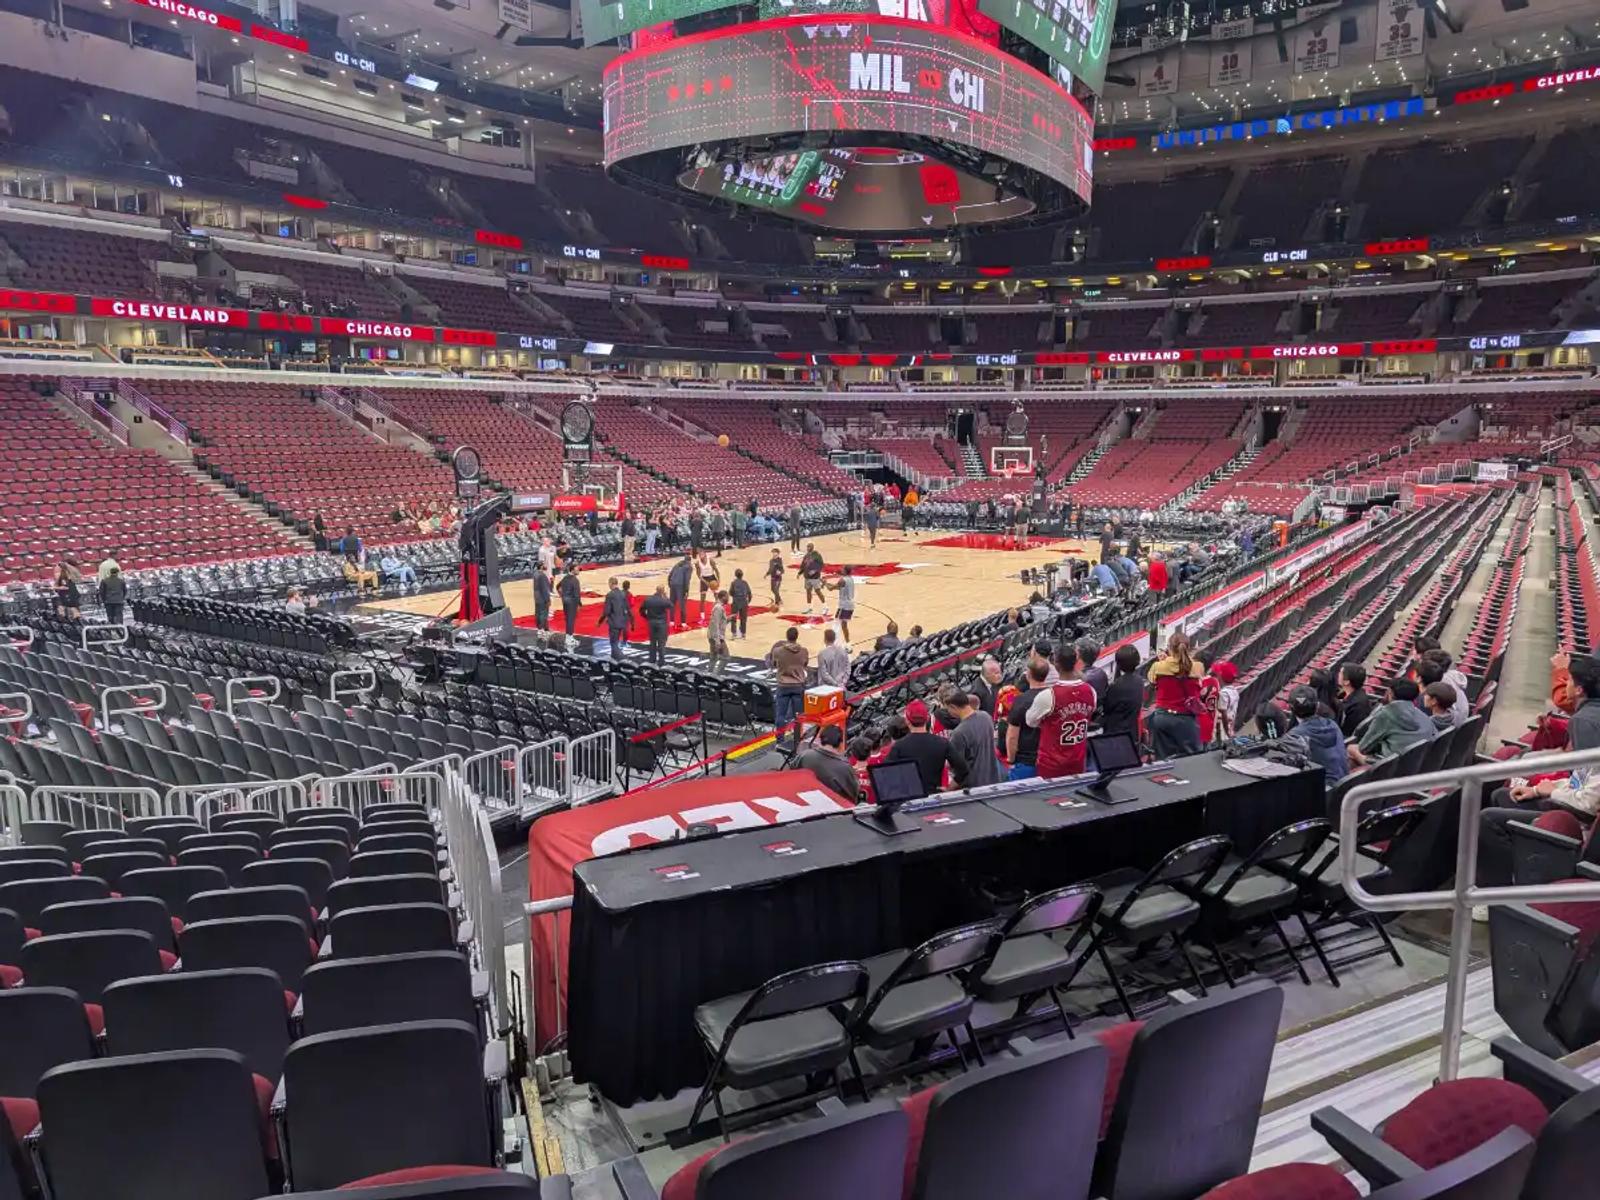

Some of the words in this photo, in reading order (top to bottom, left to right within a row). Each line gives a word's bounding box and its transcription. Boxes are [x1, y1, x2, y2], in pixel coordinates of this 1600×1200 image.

[1307, 38, 1328, 56] 23
[335, 51, 349, 65] CLE
[360, 58, 376, 73] CHI
[1153, 65, 1164, 80] 4
[850, 52, 910, 93] MIL
[948, 67, 985, 113] CHI
[1158, 119, 1269, 149] UNITED
[1302, 97, 1424, 129] CENTER
[586, 248, 600, 260] CHI
[1290, 249, 1308, 260] CHI
[112, 301, 230, 324] CLEVELAND
[346, 322, 412, 338] CHICAGO
[520, 336, 533, 348] CLE
[542, 338, 556, 350] CHI
[1470, 337, 1487, 349] CLE
[1501, 335, 1520, 348] CHI
[1108, 351, 1180, 362] CLEVELAND
[1273, 345, 1338, 357] CHICAGO
[976, 355, 990, 365] CLE
[1001, 355, 1017, 365] CHI
[829, 696, 837, 710] G
[1060, 718, 1088, 746] 23
